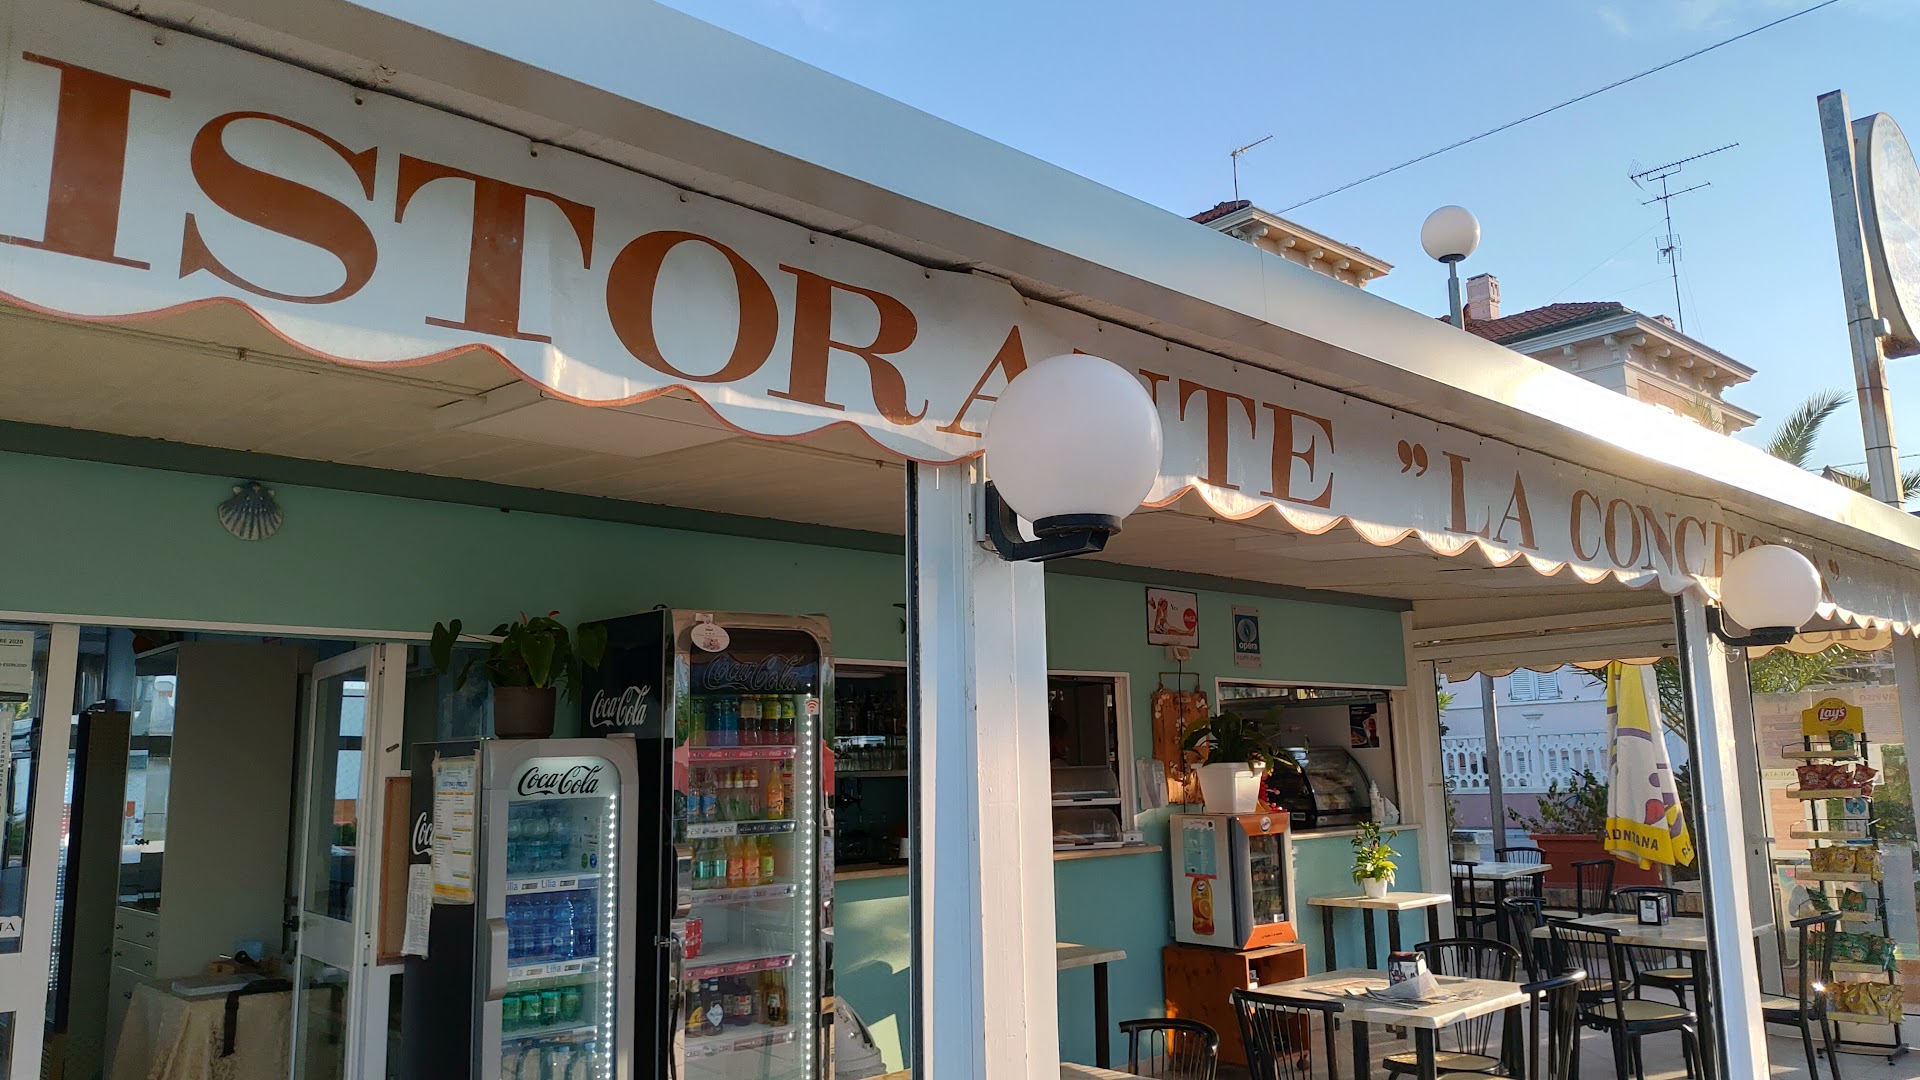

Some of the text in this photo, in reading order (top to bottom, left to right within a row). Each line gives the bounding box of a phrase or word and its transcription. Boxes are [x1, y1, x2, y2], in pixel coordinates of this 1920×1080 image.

[1239, 642, 1258, 651] opera
[704, 652, 804, 691] Coca-Cola
[589, 685, 652, 728] Coca-Cola
[517, 765, 604, 797] Coca-Cola
[541, 879, 556, 889] Lilia
[546, 964, 561, 974] Lilia
